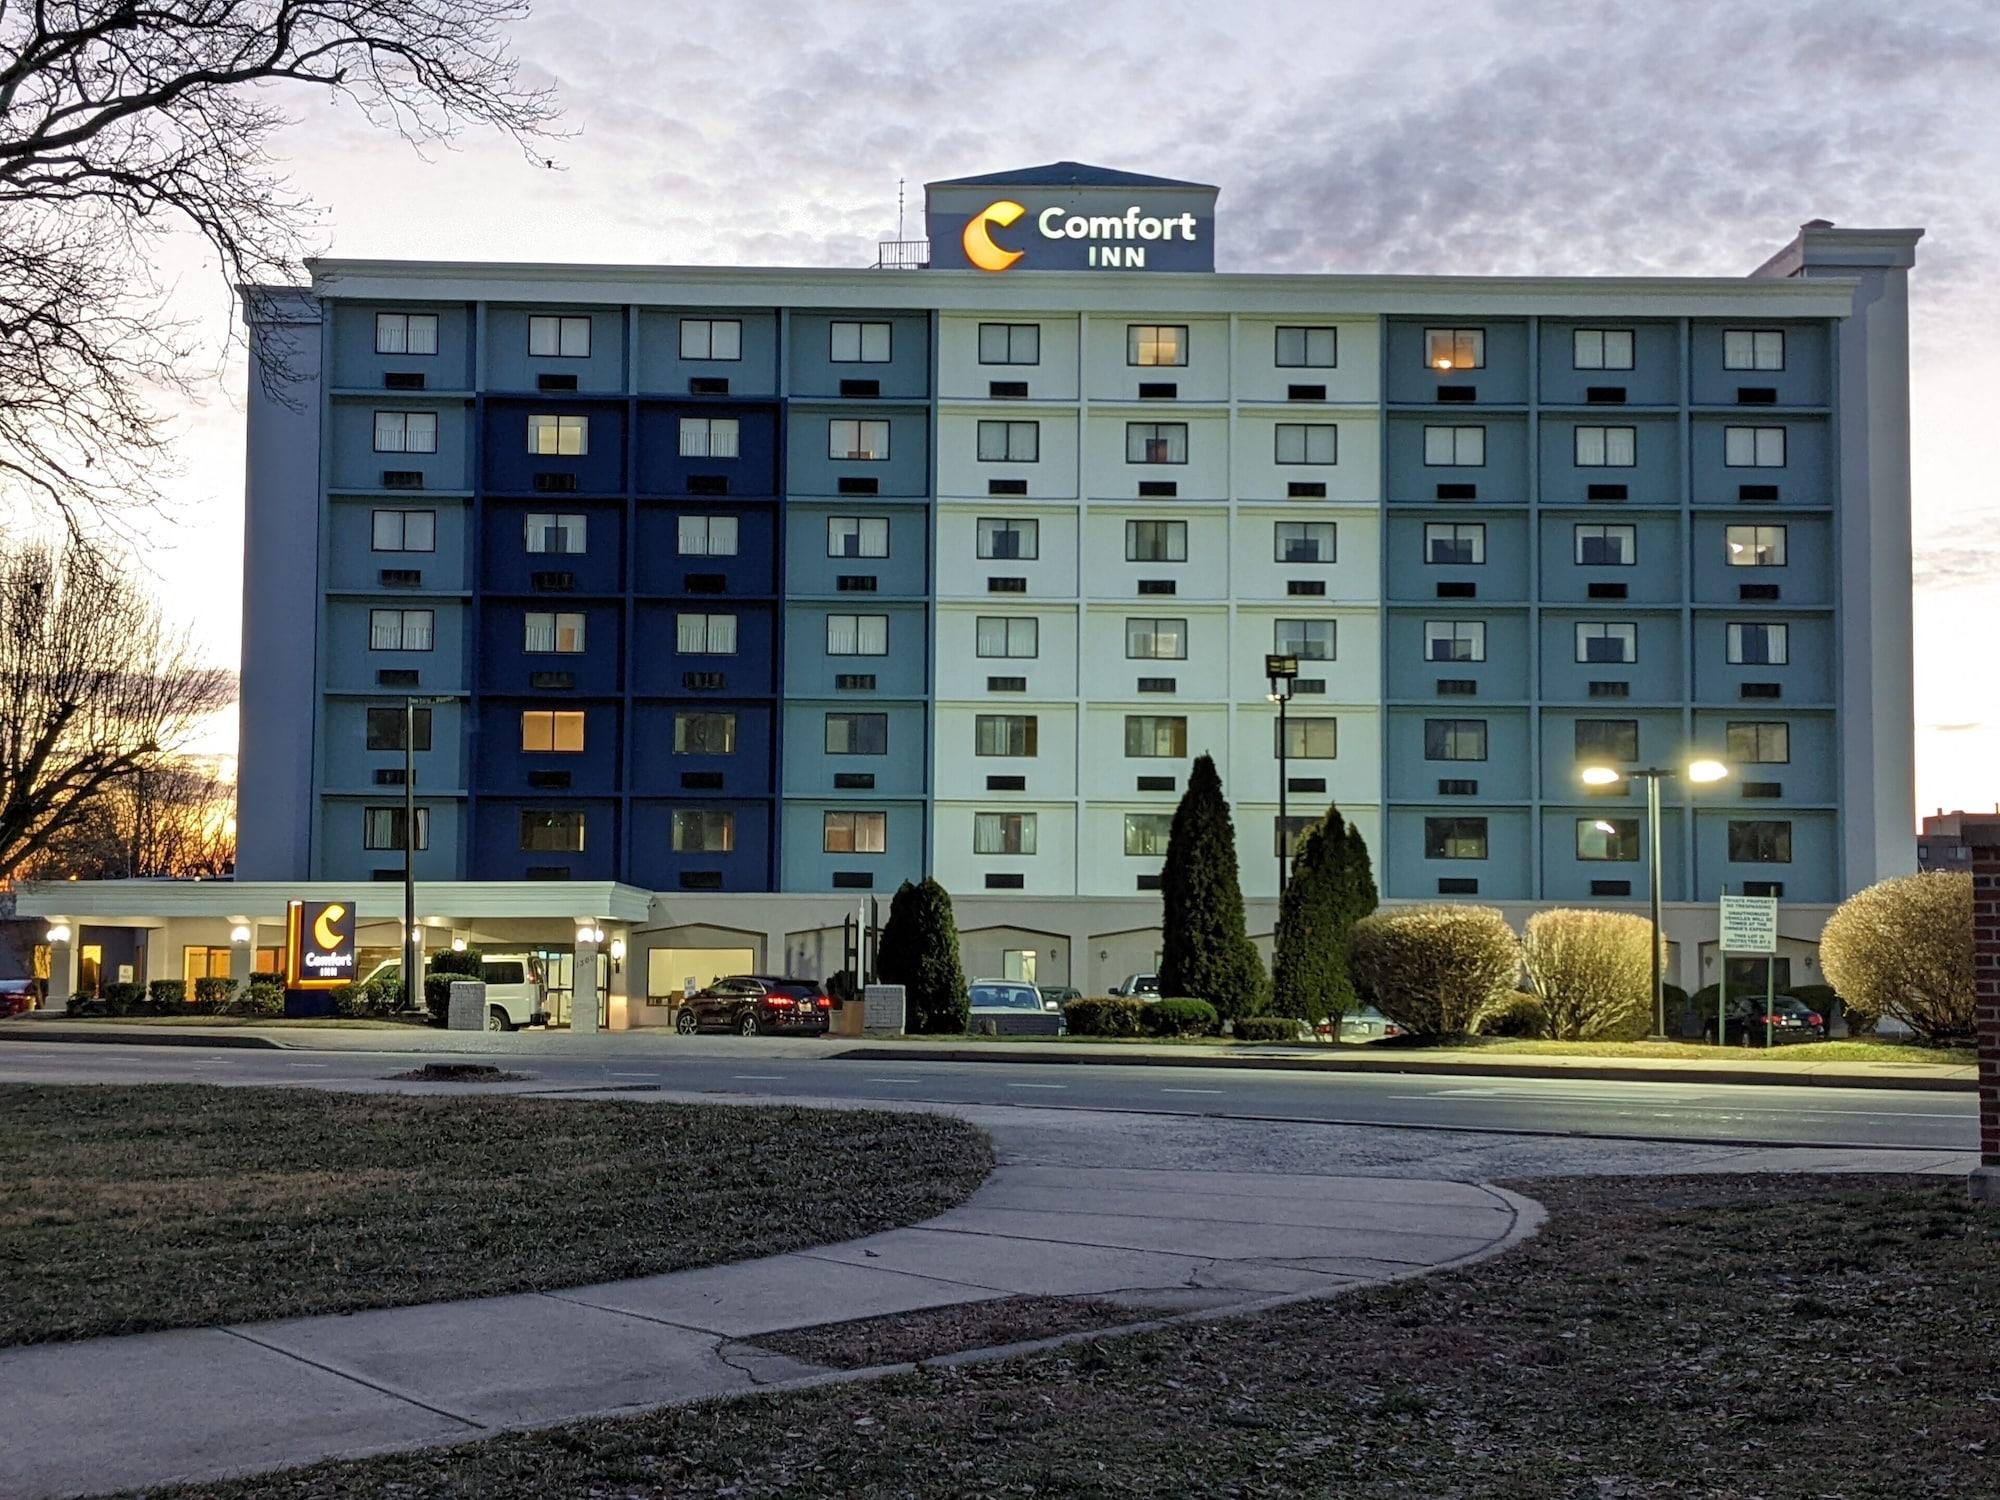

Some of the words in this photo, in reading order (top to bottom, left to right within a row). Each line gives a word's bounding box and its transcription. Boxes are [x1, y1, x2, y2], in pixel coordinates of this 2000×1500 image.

[1038, 206, 1196, 240] Comfort
[1089, 246, 1145, 267] INN
[305, 951, 352, 967] Comfort
[320, 967, 338, 976] INN
